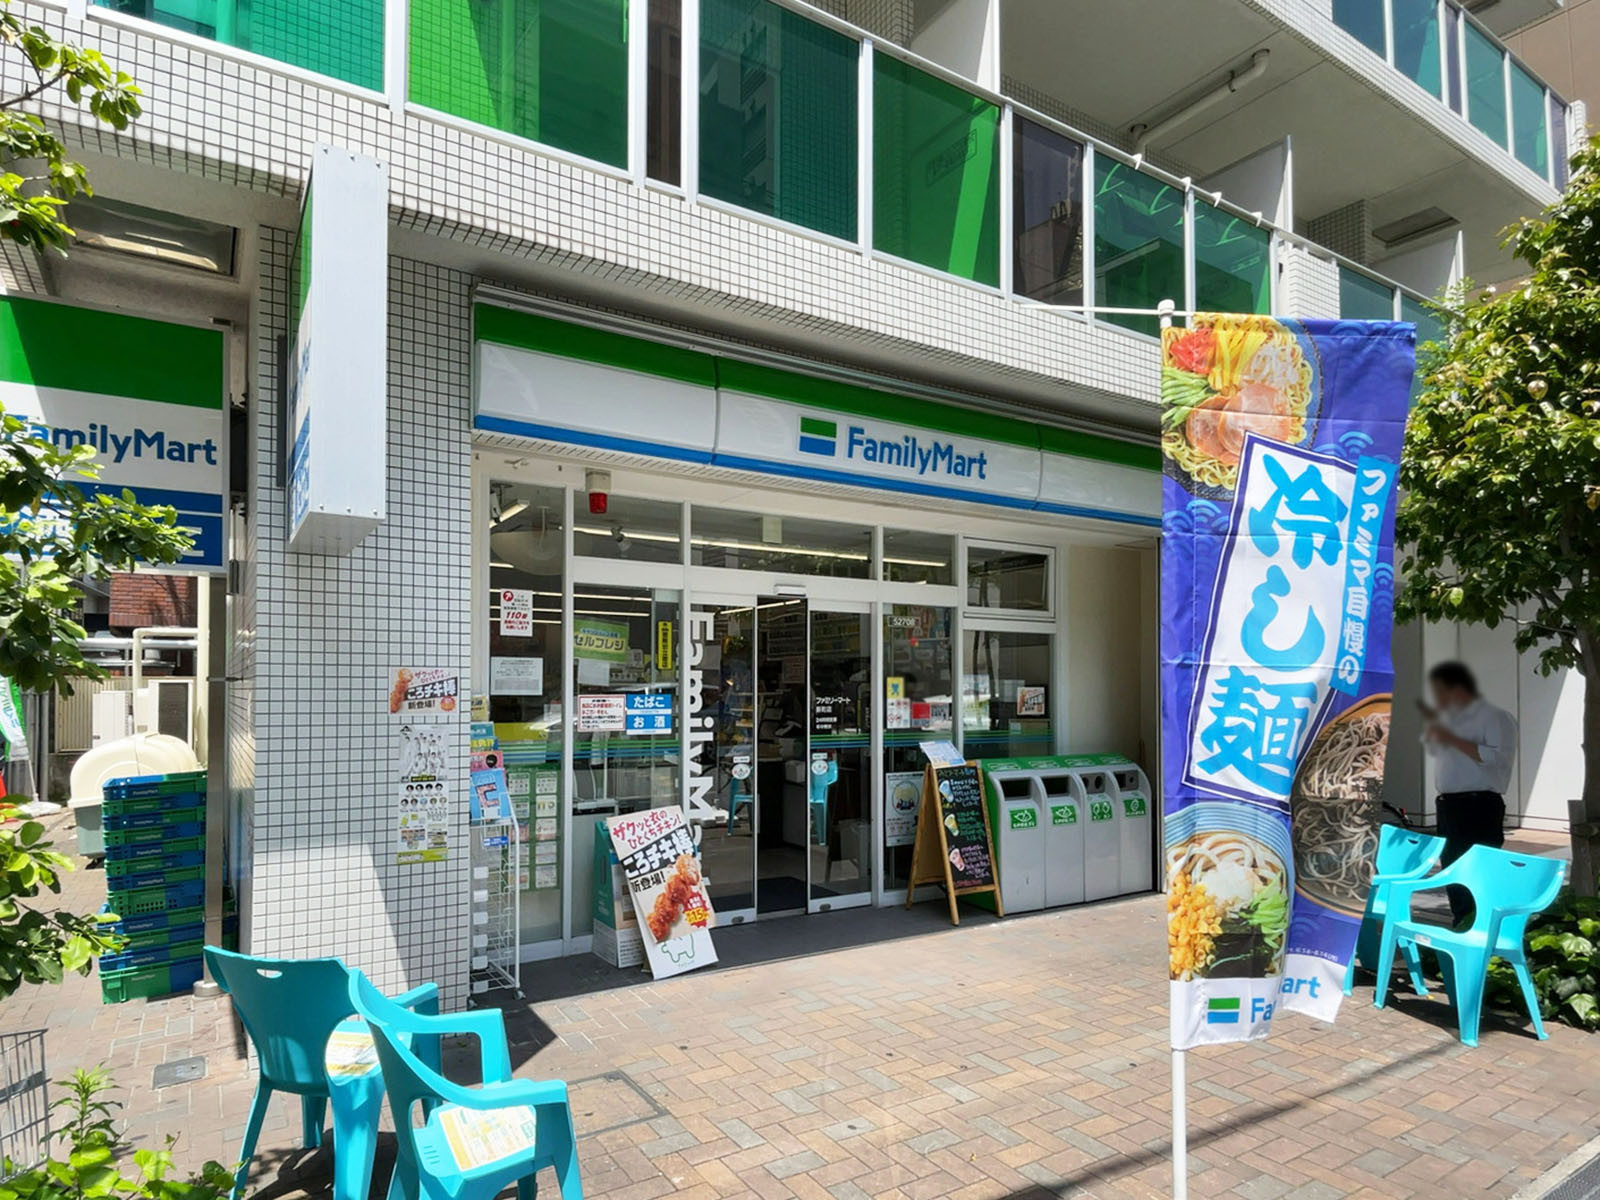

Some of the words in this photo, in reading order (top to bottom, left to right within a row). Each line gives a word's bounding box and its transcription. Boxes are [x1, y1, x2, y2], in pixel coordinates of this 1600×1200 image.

[848, 427, 988, 480] FamilyMart
[1196, 452, 1349, 801] 冷し麺
[633, 696, 665, 708] たばこ
[1278, 976, 1321, 999] art
